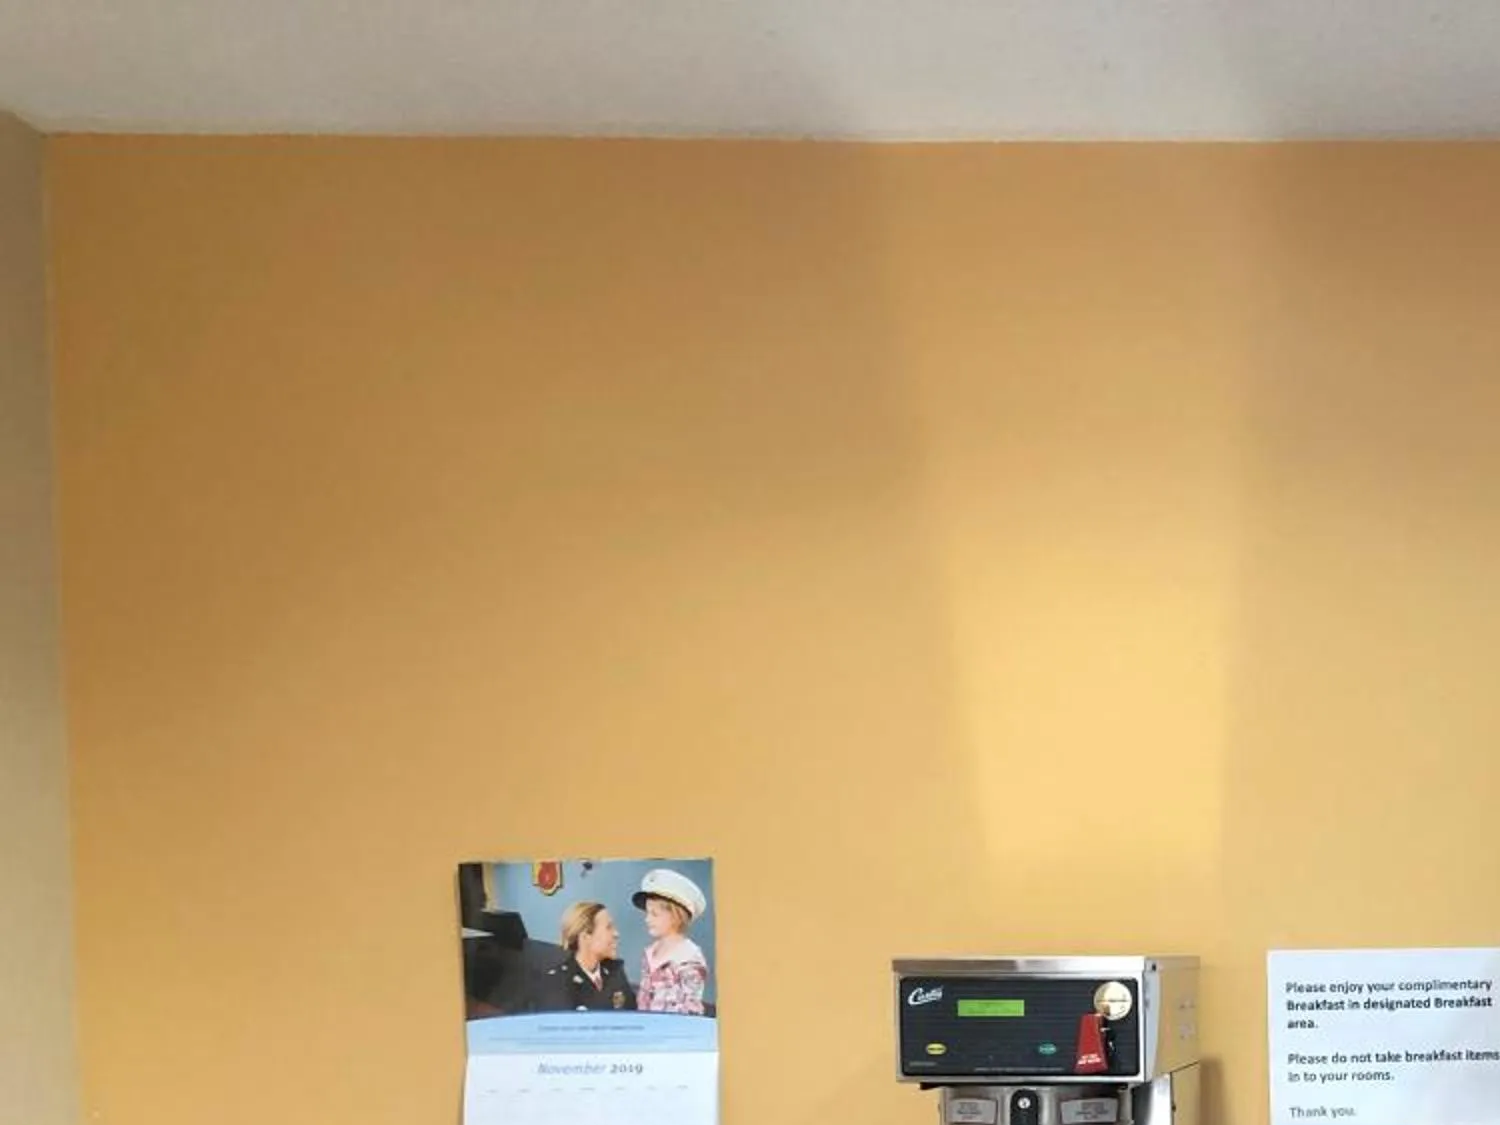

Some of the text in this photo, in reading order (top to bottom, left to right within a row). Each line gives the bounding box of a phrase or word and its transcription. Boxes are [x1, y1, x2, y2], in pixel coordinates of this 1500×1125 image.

[1286, 979, 1493, 995] Please enjoy your complimentary
[1287, 995, 1493, 1012] Breakfast in designated Breakfast
[1287, 1017, 1318, 1029] area.
[1288, 1048, 1500, 1065] Please do not take breakfast items
[537, 1061, 643, 1075] November 2019
[1288, 1069, 1395, 1084] in to your rooms.
[1289, 1106, 1357, 1120] Thank you.
